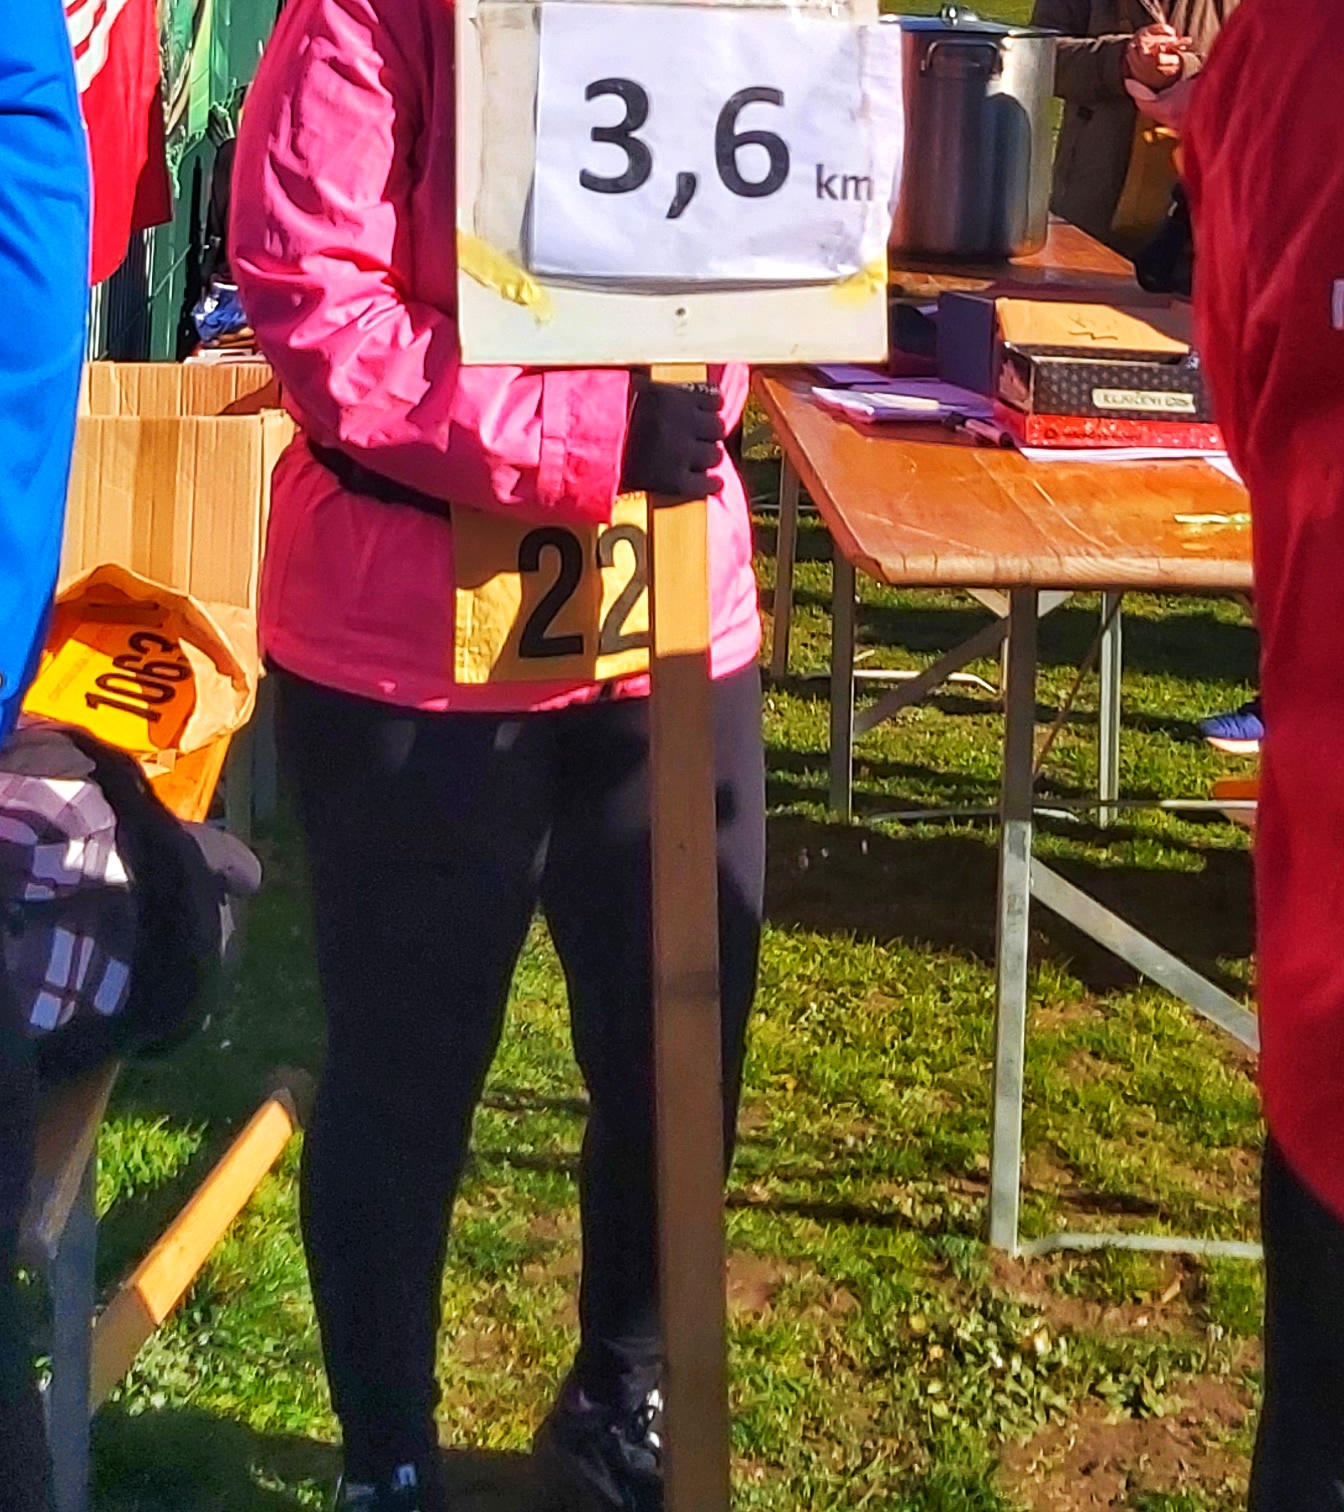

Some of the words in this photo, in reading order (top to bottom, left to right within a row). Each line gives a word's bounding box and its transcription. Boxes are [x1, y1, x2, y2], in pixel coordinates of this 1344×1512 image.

[579, 77, 791, 221] 3,6
[814, 164, 874, 202] km
[518, 523, 650, 658] 22
[84, 631, 193, 724] 1063
